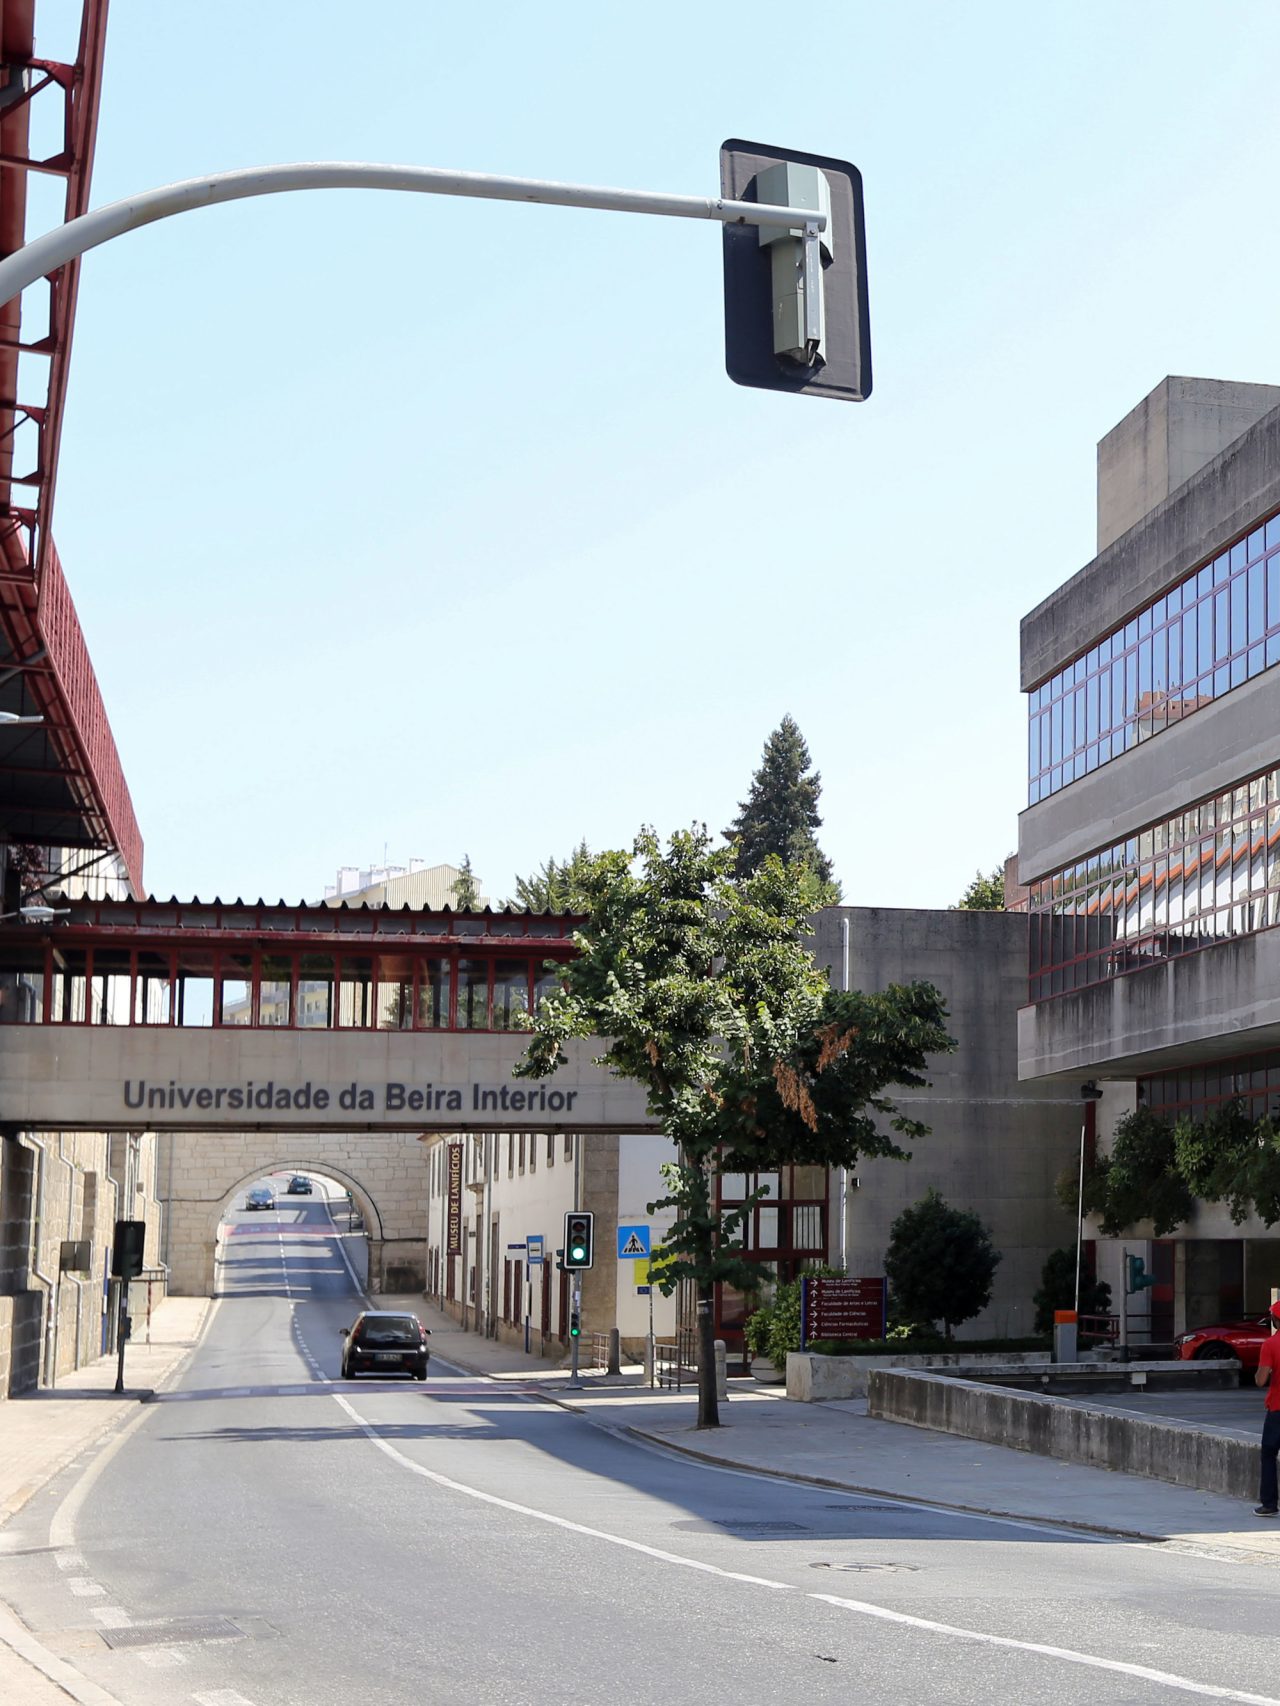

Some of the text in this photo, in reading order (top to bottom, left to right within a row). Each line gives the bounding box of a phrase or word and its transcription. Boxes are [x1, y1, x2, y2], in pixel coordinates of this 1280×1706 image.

[124, 1080, 578, 1112] Universidade da Beira Interior
[449, 1147, 460, 1249] MUSEU DE LANIFÍCIOS
